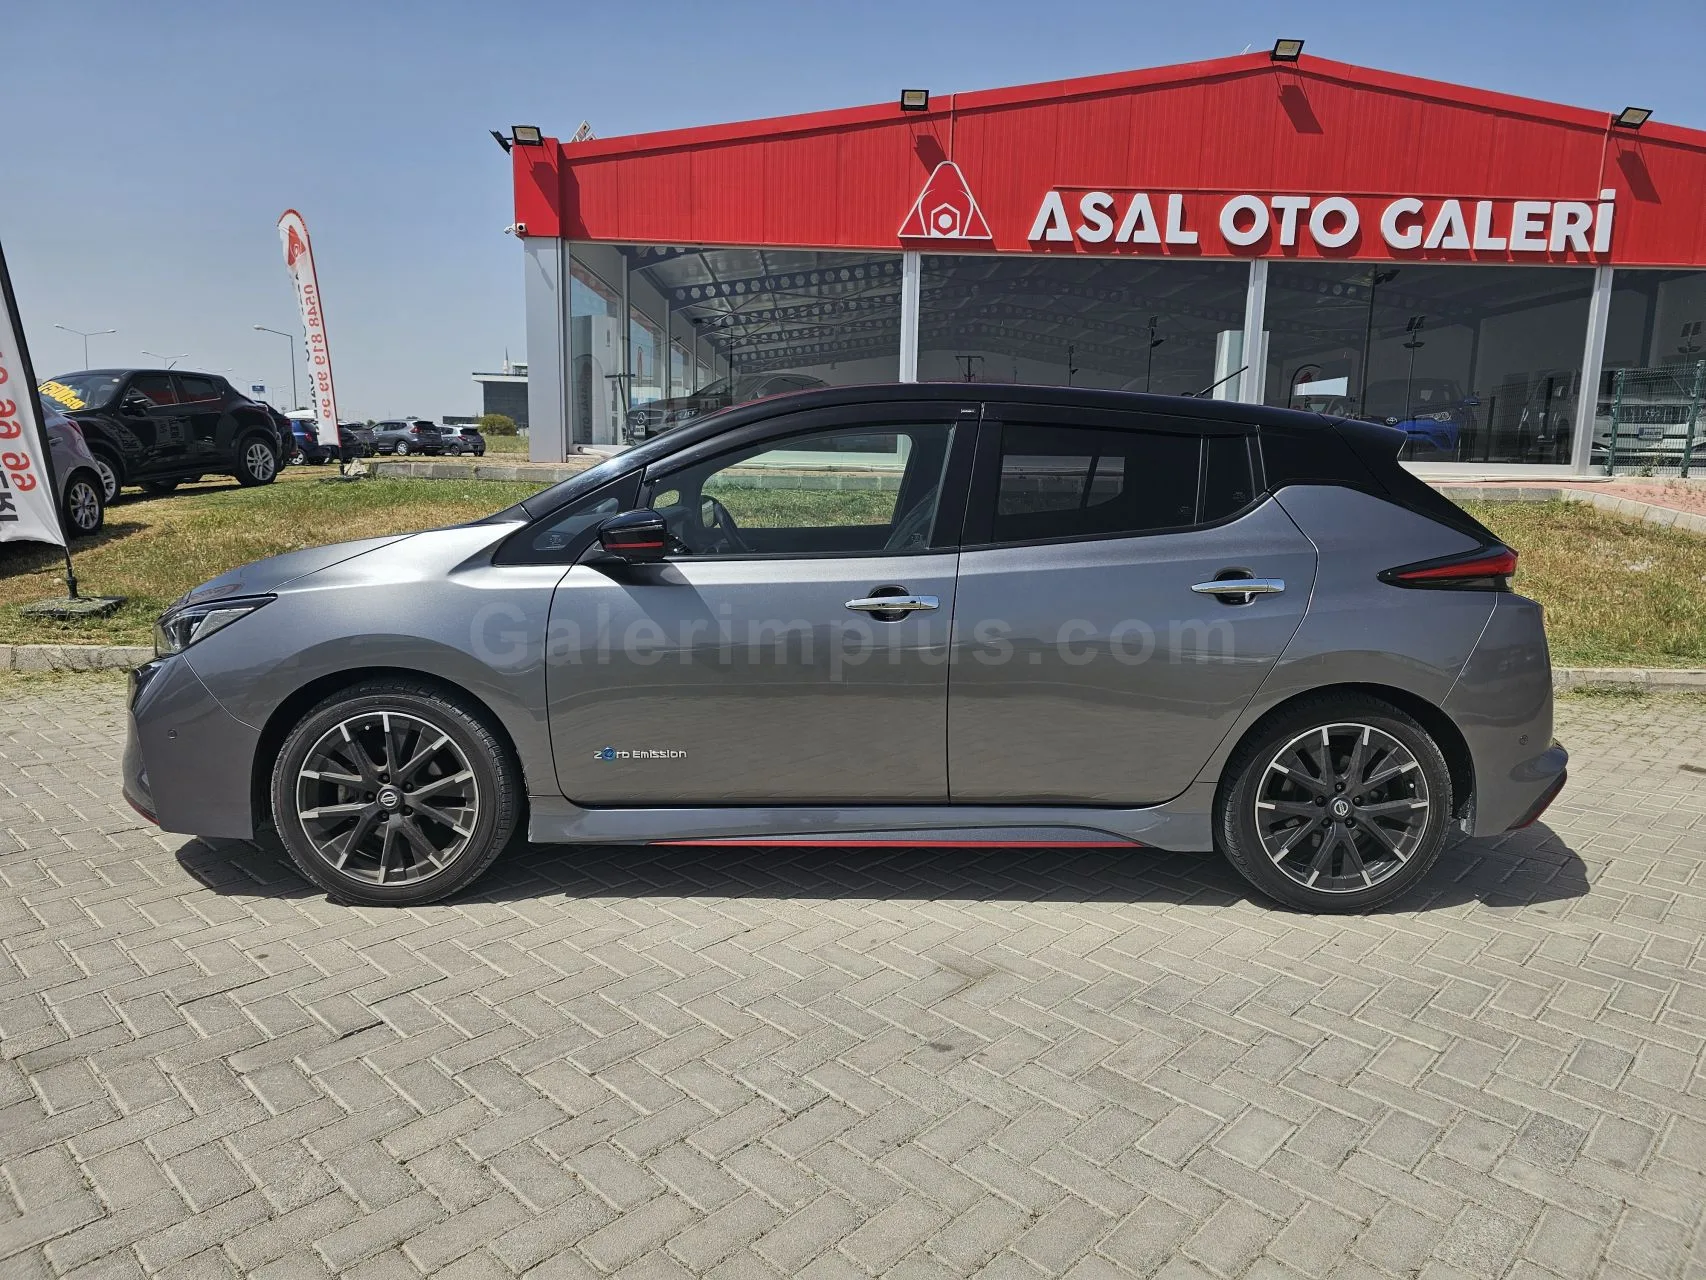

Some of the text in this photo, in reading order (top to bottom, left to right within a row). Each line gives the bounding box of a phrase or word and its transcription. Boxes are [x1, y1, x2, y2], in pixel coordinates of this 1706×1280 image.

[1027, 188, 1616, 253] ASAL OTO GALERİ
[632, 749, 687, 759] Emission
